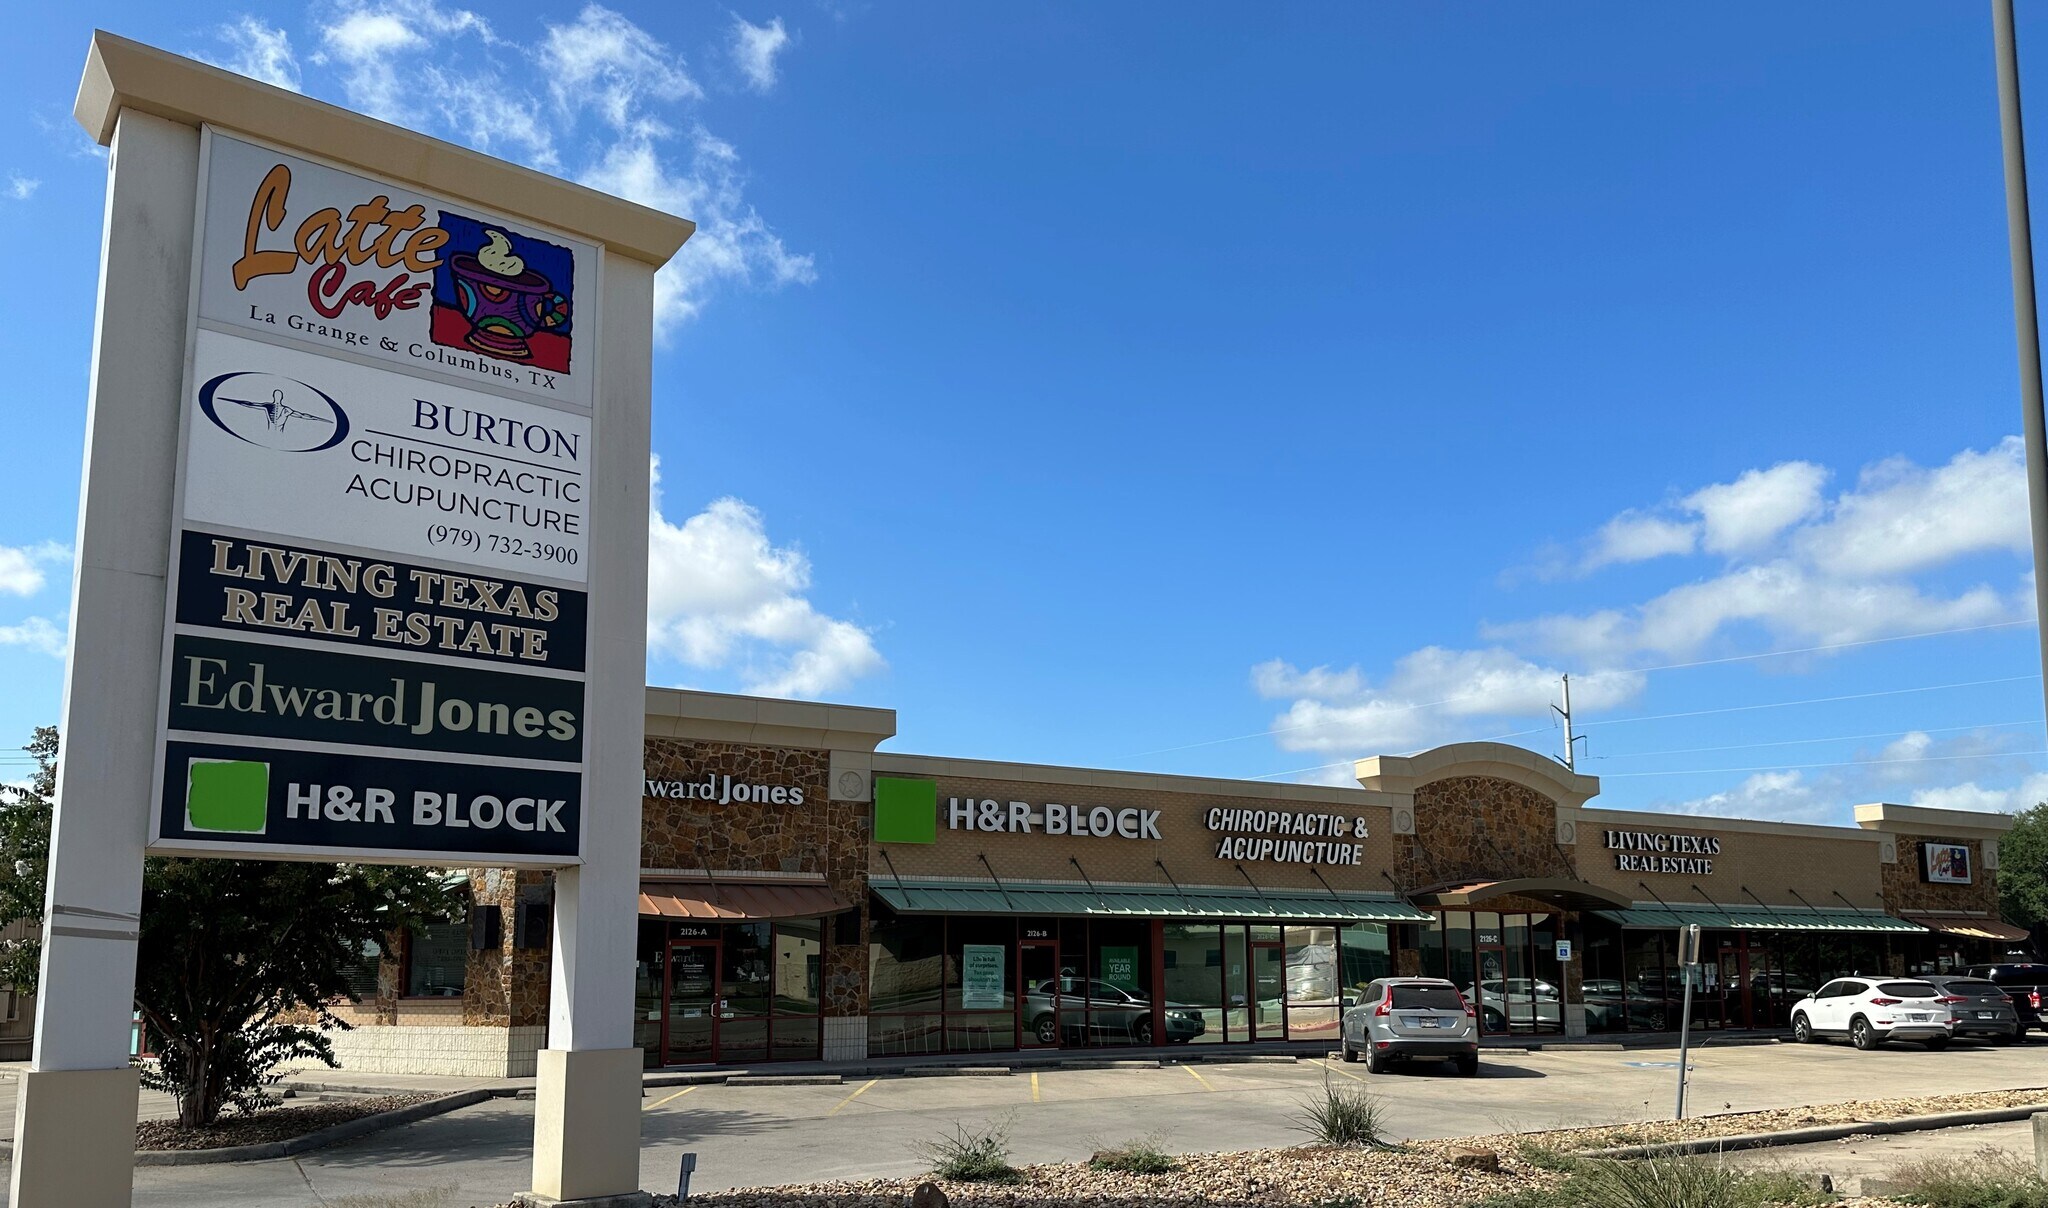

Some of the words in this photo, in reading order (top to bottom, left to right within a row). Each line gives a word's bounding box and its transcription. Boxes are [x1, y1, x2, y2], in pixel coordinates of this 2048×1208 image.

[232, 163, 450, 291] Latte
[307, 261, 432, 320] Café
[249, 304, 276, 325] La
[288, 314, 370, 346] Grange
[379, 336, 399, 352] &
[408, 343, 520, 383] Columbus,
[528, 370, 556, 390] TX
[411, 398, 581, 461] BURTON
[351, 439, 581, 503] CHIROPRACTIC
[345, 473, 580, 535] ACUPUNCTURE
[427, 524, 481, 552] (979)
[487, 534, 578, 565] 732-3900
[209, 539, 397, 598] LIVING
[409, 569, 559, 622] TEXAS
[221, 587, 361, 638] REAL
[372, 607, 549, 661] ESTATE
[285, 783, 397, 824] H&R
[412, 790, 567, 833] BLOCK
[949, 797, 1032, 834] H&R
[1045, 803, 1163, 840] BLOCK
[1207, 807, 1346, 837] CHIROPRACTIC
[1354, 816, 1369, 838] &
[1217, 837, 1364, 866] ACUPUNCTURE
[1607, 830, 1666, 852] LIVING
[1669, 834, 1721, 855] TEXAS
[1619, 854, 1659, 872] REAL
[1661, 857, 1713, 875] ESTATE
[680, 928, 707, 936] 2126-A
[1108, 964, 1131, 973] YEAR
